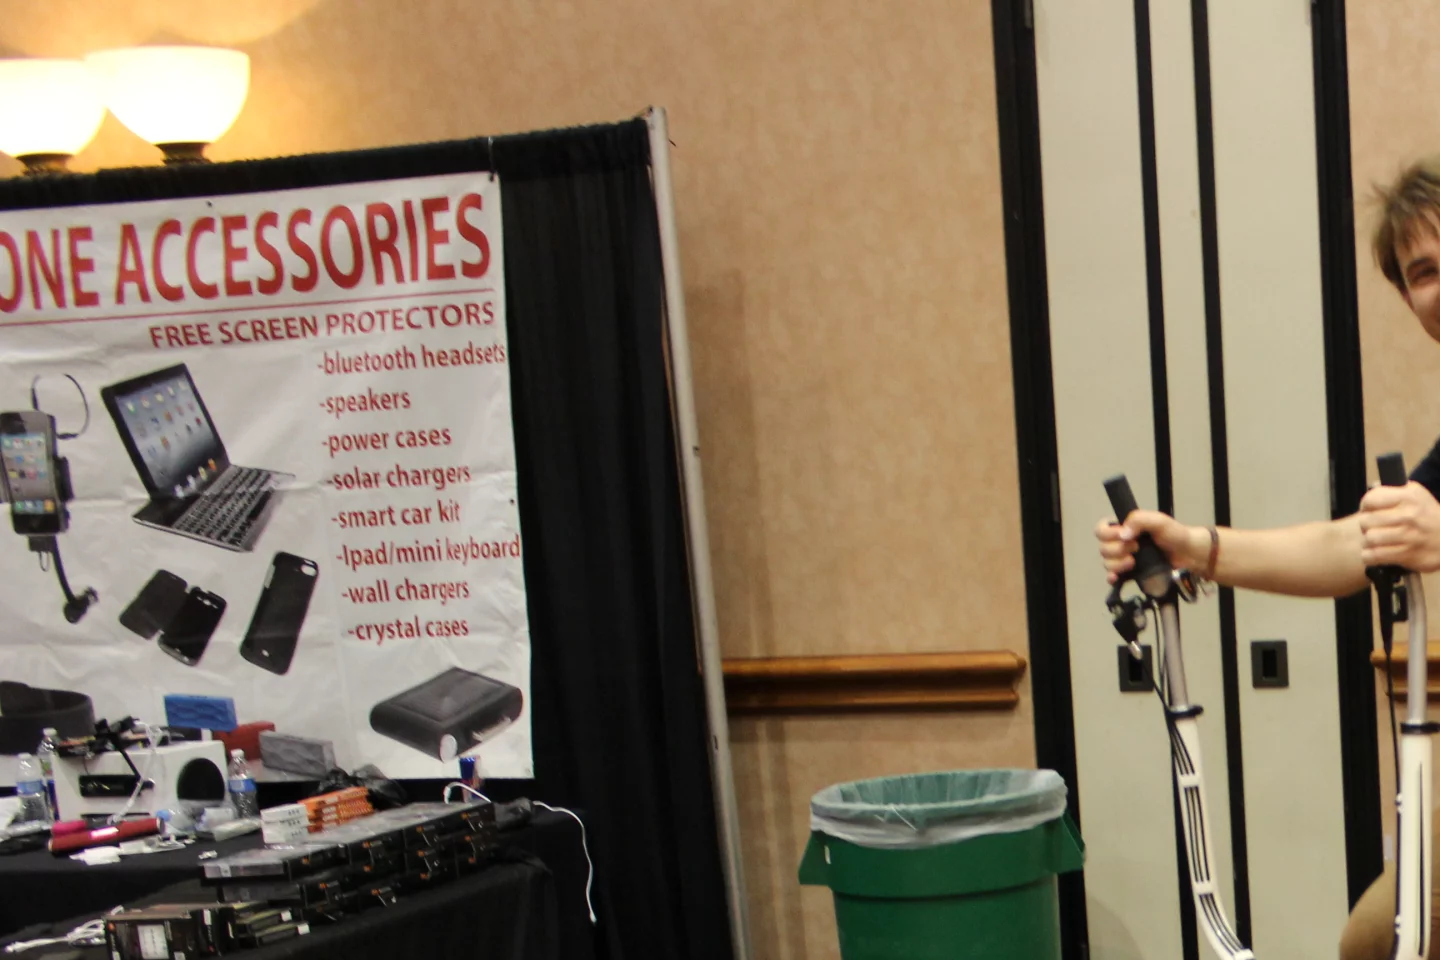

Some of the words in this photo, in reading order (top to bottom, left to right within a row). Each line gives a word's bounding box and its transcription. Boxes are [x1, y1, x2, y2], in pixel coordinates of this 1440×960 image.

[0, 226, 100, 313] ONE
[114, 192, 492, 305] ACCESSORIES
[149, 321, 214, 349] FREE
[220, 315, 319, 344] SCREEN
[325, 301, 495, 336] PROTECTORS
[317, 344, 416, 375] -bluetooth
[420, 339, 506, 368] headsets
[319, 386, 411, 419] -speakers
[321, 430, 389, 458] -power
[395, 427, 452, 449] cases
[326, 465, 382, 491] -solar
[386, 462, 472, 491] chargers
[331, 504, 396, 529] -smart
[401, 505, 433, 526] car
[436, 498, 461, 523] kit
[444, 533, 521, 566] keyboard
[341, 578, 390, 605] -wall
[395, 577, 470, 605] chargers
[347, 614, 421, 647] -crystal
[425, 618, 470, 638] cases
